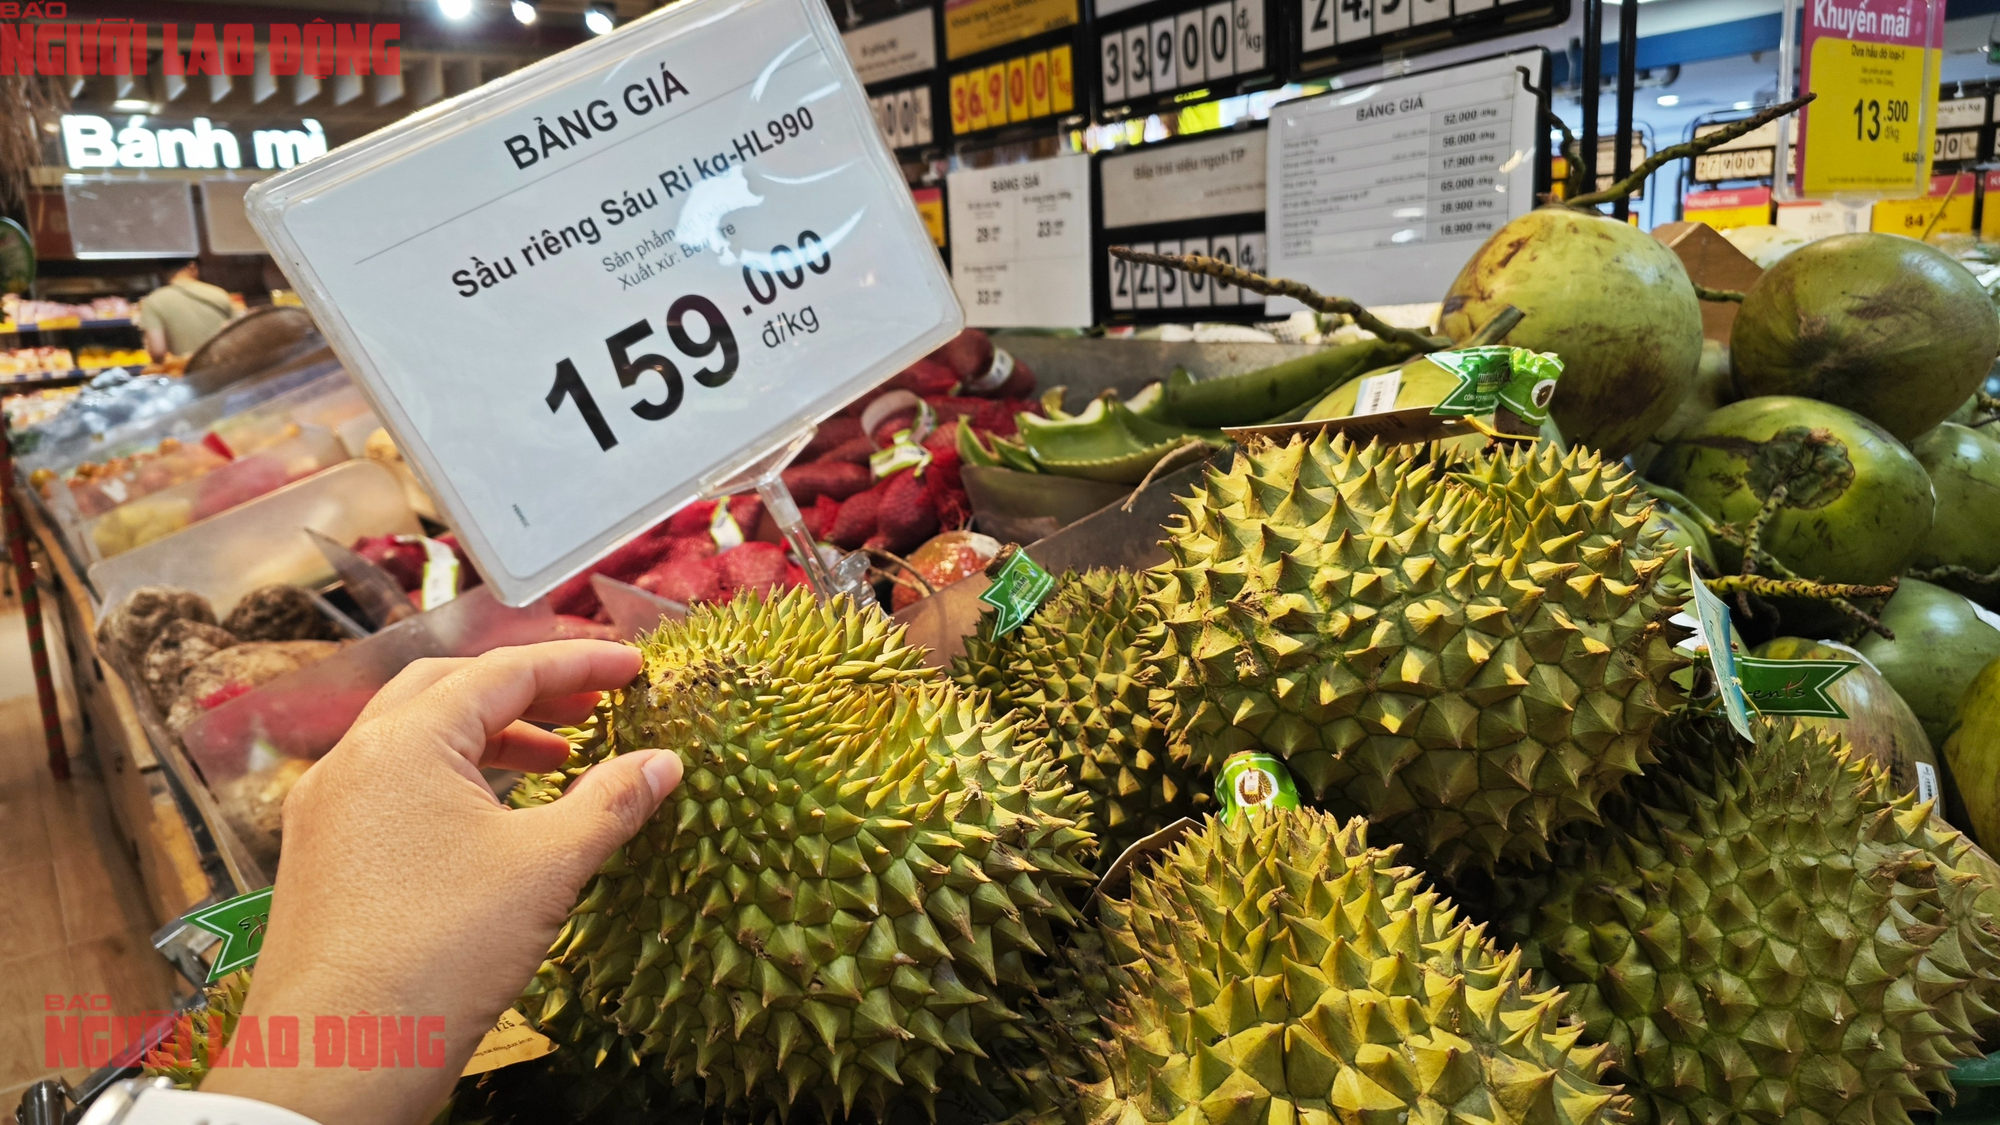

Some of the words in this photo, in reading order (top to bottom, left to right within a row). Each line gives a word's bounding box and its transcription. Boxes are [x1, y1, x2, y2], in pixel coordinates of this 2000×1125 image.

[1881, 7, 1910, 38] mãi
[503, 100, 619, 170] BẢNG
[623, 61, 690, 116] GIÁ
[1399, 92, 1424, 114] GIÁ
[1854, 98, 1881, 142] 13
[1883, 100, 1909, 123] .500
[61, 114, 240, 169] Bánh
[452, 254, 518, 298] Sầu
[521, 215, 602, 267] riêng
[600, 186, 658, 227] Sáu
[658, 164, 693, 200] Ri
[602, 251, 635, 272] Sản
[636, 229, 676, 260] phẩm
[618, 261, 656, 291] Xuất
[762, 304, 819, 349] đ/kg
[545, 294, 739, 452] 159
